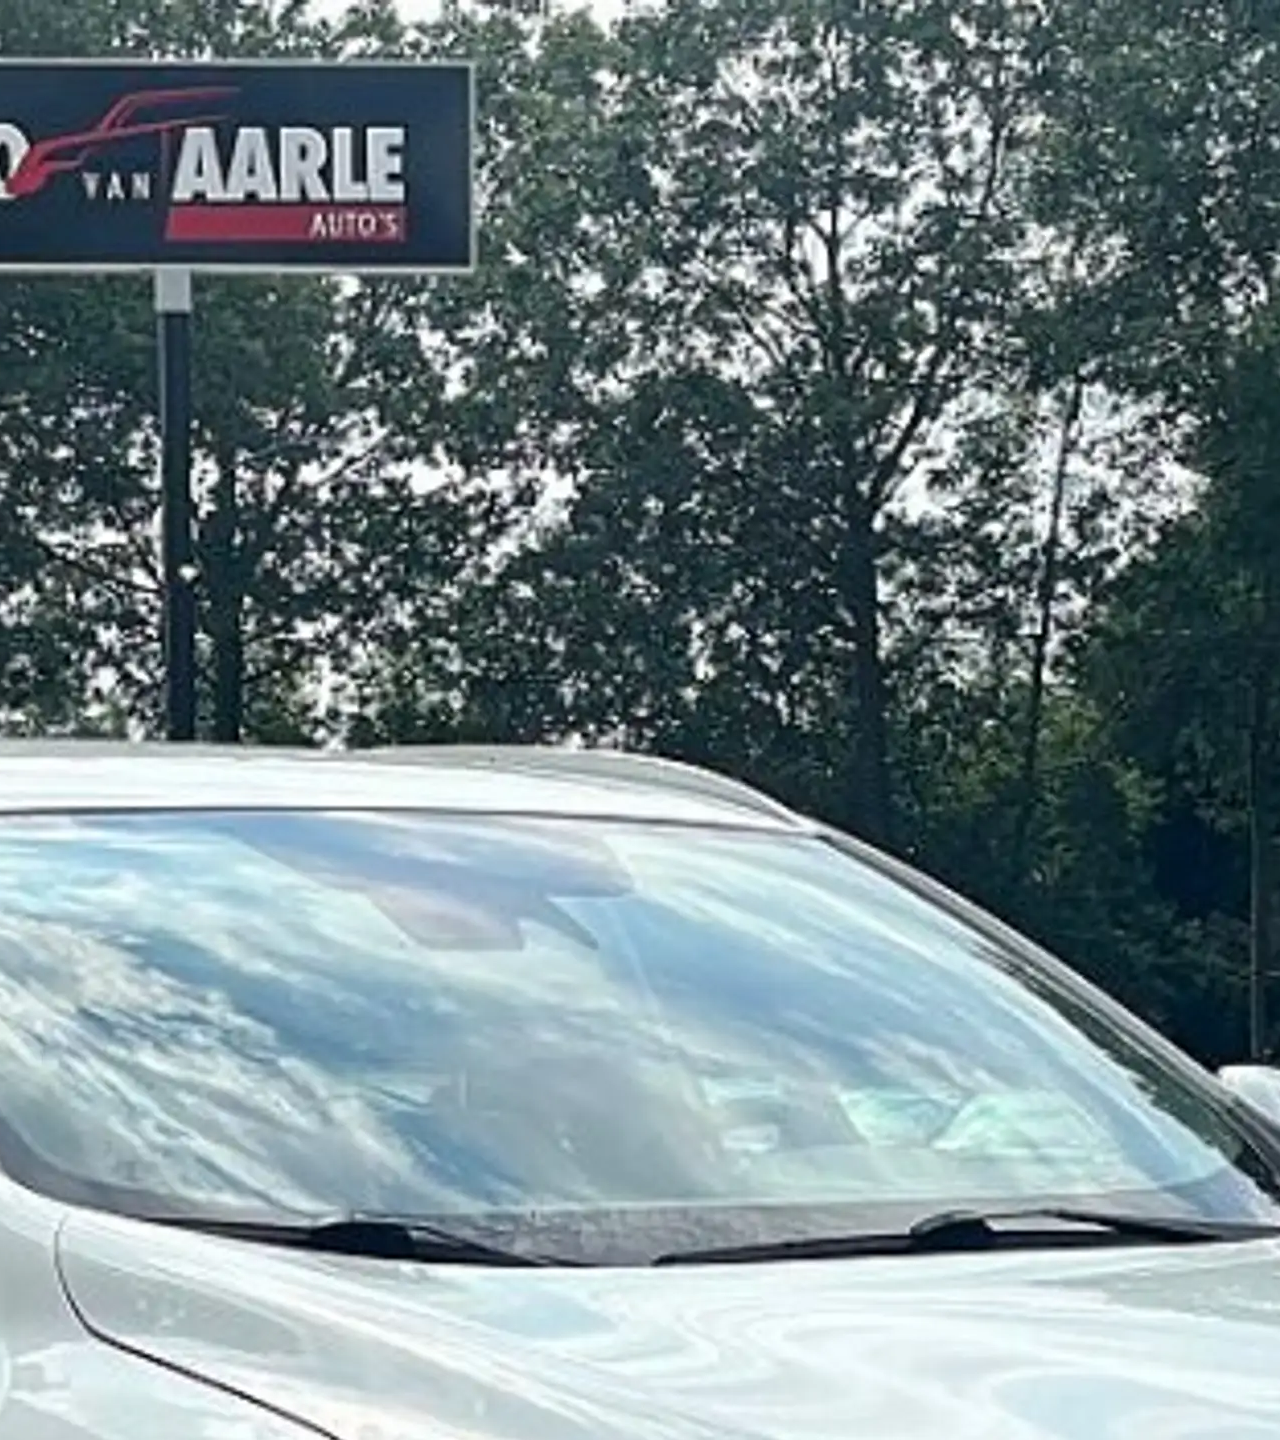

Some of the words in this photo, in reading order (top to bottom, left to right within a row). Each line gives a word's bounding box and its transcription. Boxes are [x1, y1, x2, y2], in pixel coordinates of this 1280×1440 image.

[82, 170, 151, 200] VAN
[171, 126, 405, 202] AARLE
[308, 212, 399, 239] AUTO'S
